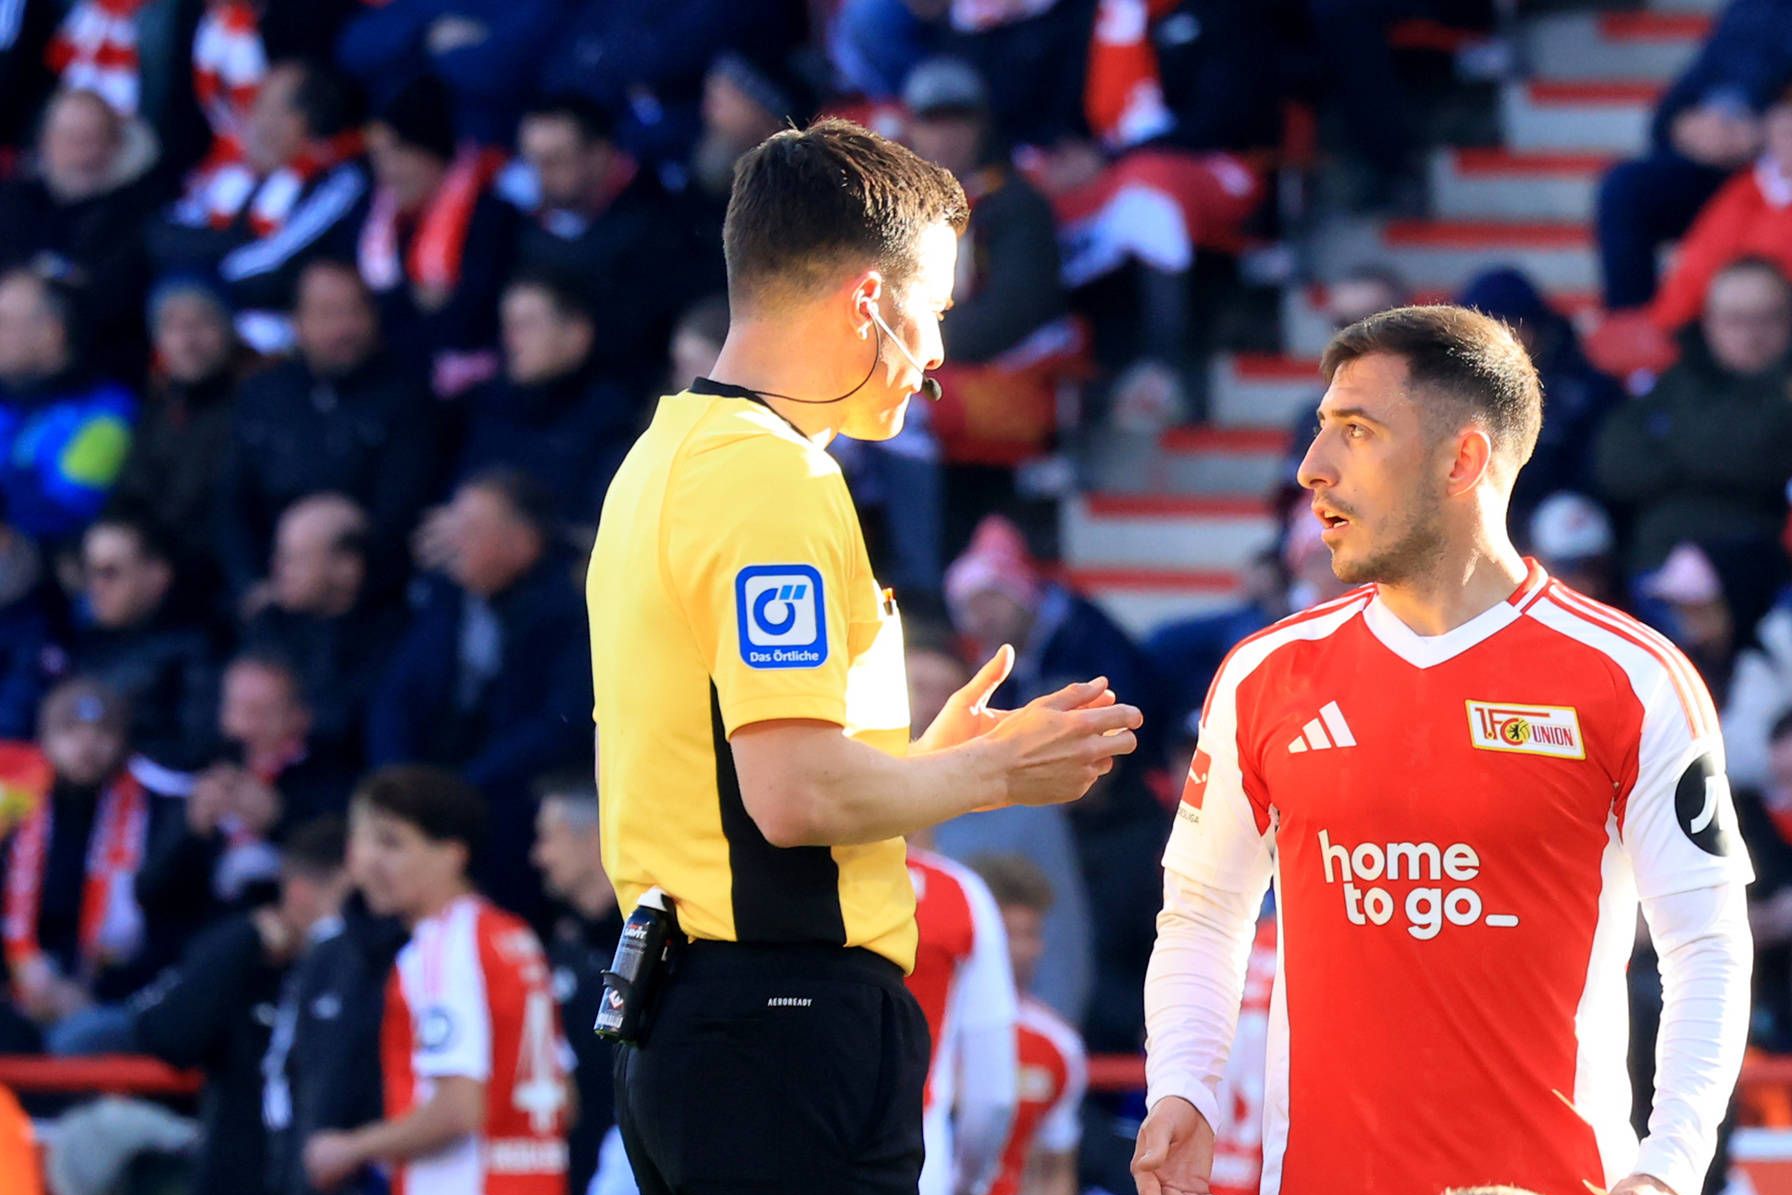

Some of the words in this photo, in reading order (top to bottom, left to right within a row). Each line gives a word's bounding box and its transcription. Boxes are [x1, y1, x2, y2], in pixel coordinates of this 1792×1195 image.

[750, 652, 771, 662] Das
[773, 649, 819, 662] Örtliche
[1532, 725, 1574, 747] UNION
[1318, 829, 1480, 883] home
[1343, 882, 1394, 925] to
[767, 997, 812, 1007] AEROREADY
